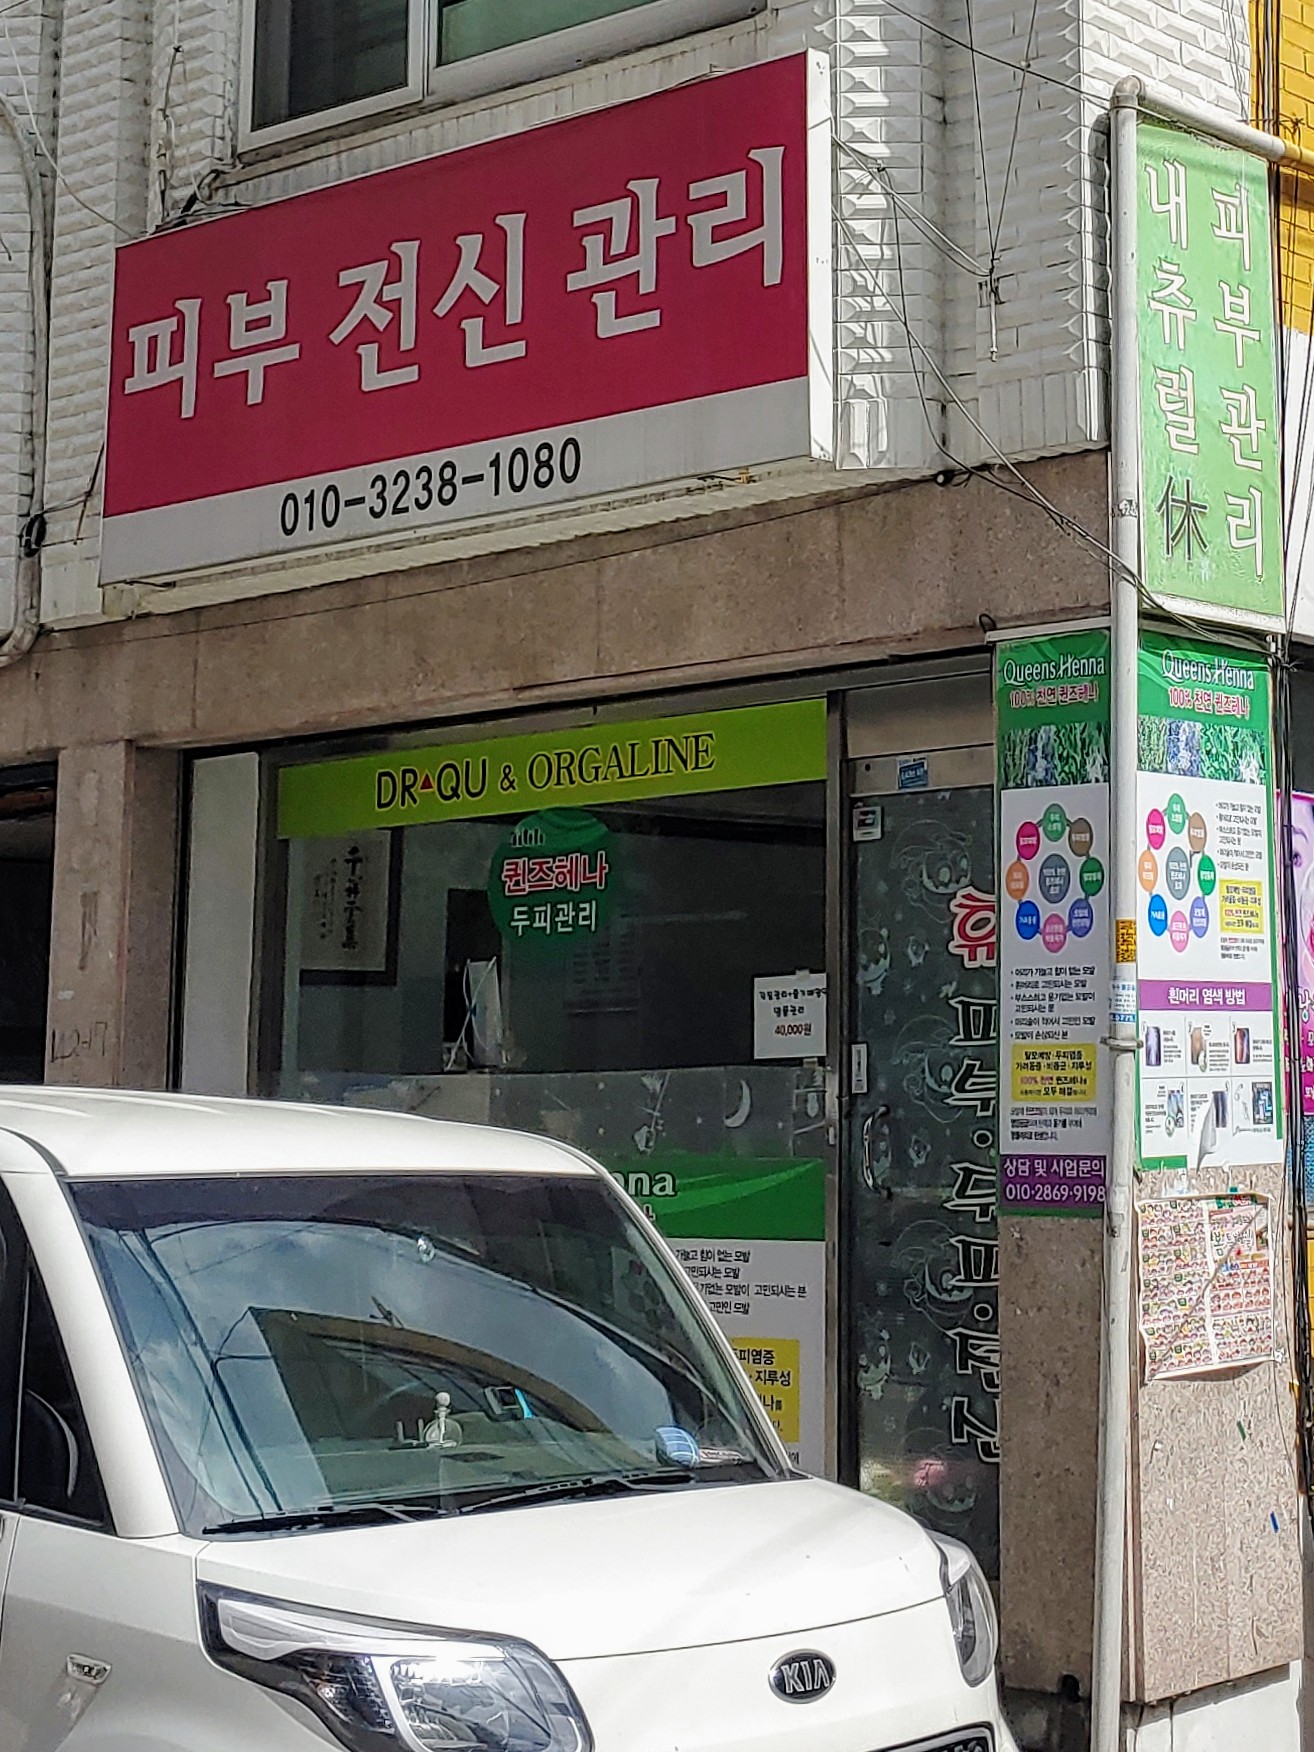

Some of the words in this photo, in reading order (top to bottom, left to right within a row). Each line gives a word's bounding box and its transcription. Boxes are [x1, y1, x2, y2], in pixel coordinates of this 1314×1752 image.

[124, 279, 300, 419] 피부
[328, 213, 527, 392] 전신
[567, 146, 785, 338] 관리
[1211, 182, 1267, 580] 피부관리
[280, 437, 581, 537] 010-3238-1080
[1036, 686, 1057, 707] 천연
[1168, 686, 1193, 709] 100%
[1194, 688, 1213, 713] 천연
[499, 764, 517, 792] &
[528, 732, 716, 790] ORGALINE
[502, 851, 608, 895] 퀸즈헤나
[511, 900, 596, 936] 두피관리
[1167, 986, 1200, 1005] 흰머리
[1202, 987, 1223, 1006] 염색
[1224, 987, 1246, 1006] 방법
[1004, 1158, 1031, 1178] 상담
[1034, 1158, 1047, 1177] 및
[1050, 1158, 1105, 1178] 사업문의
[754, 1369, 791, 1387] 지루성
[781, 1659, 830, 1694] KIA
